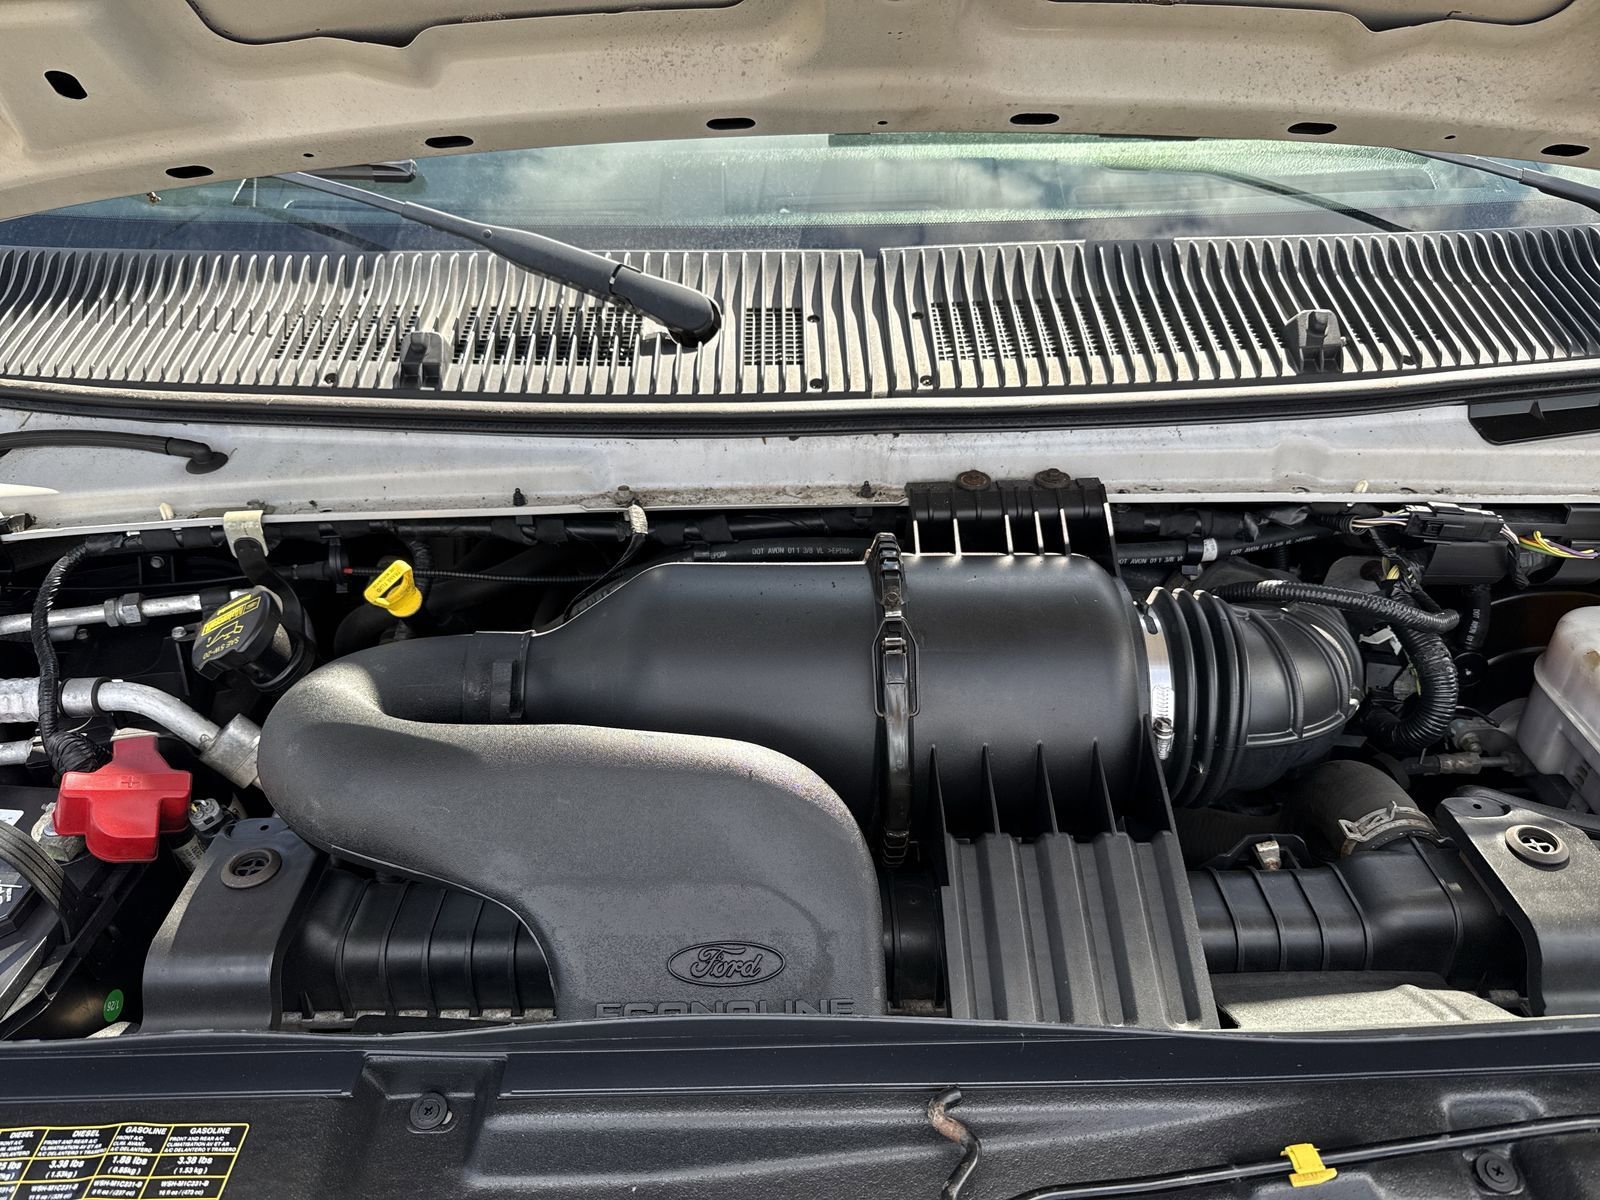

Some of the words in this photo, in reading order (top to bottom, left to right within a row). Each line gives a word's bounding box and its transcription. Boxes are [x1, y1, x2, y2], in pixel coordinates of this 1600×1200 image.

[690, 945, 763, 979] Ford
[72, 1129, 100, 1138] DIESEL
[125, 1126, 167, 1135] GASOLINE
[189, 1127, 231, 1135] GASOLINE
[132, 1155, 148, 1165] lbs
[198, 1156, 213, 1165] lbs
